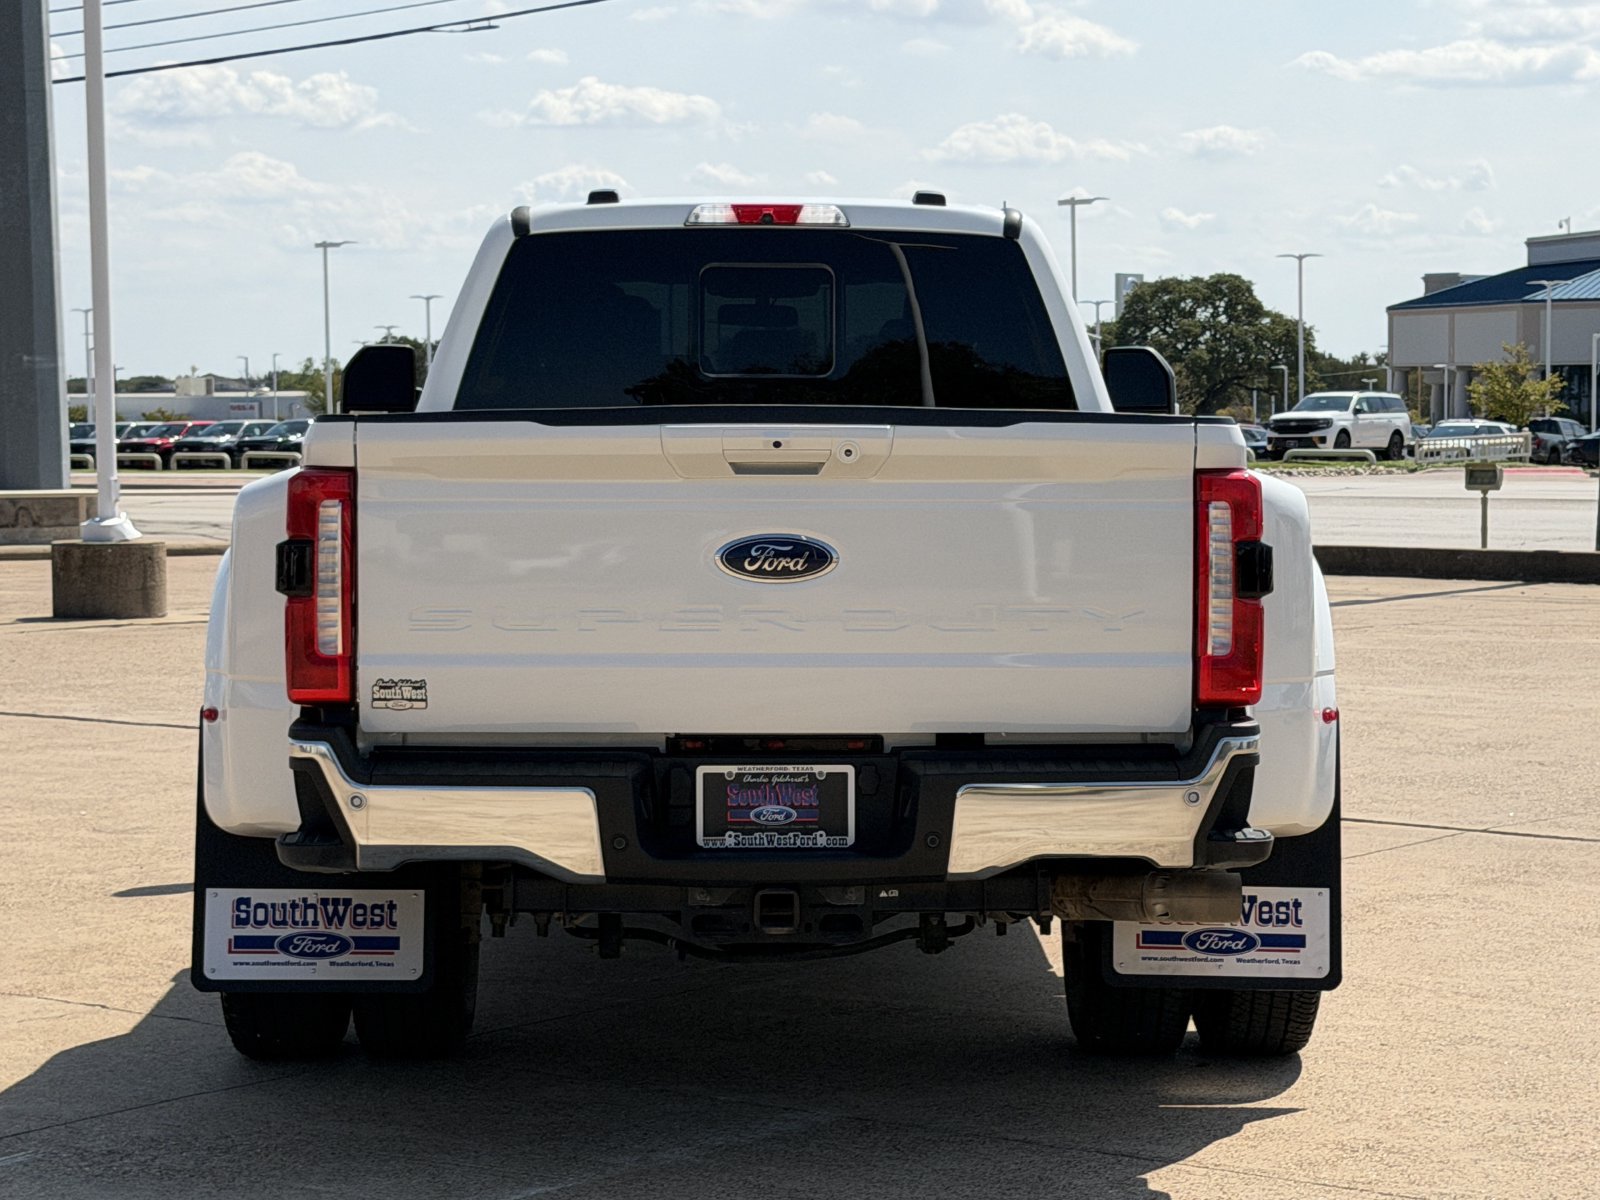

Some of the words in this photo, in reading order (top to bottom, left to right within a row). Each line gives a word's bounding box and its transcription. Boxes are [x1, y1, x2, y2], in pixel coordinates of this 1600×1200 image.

[744, 544, 809, 571] Ford
[408, 604, 804, 631] SUPER
[841, 604, 1147, 631] DUTY
[727, 784, 819, 807] SouthWest
[760, 809, 787, 821] Ford
[703, 832, 848, 848] www.SouthWestFord.com
[232, 897, 398, 930] SouthWest
[289, 935, 341, 954] Ford
[1195, 931, 1247, 951] Ford
